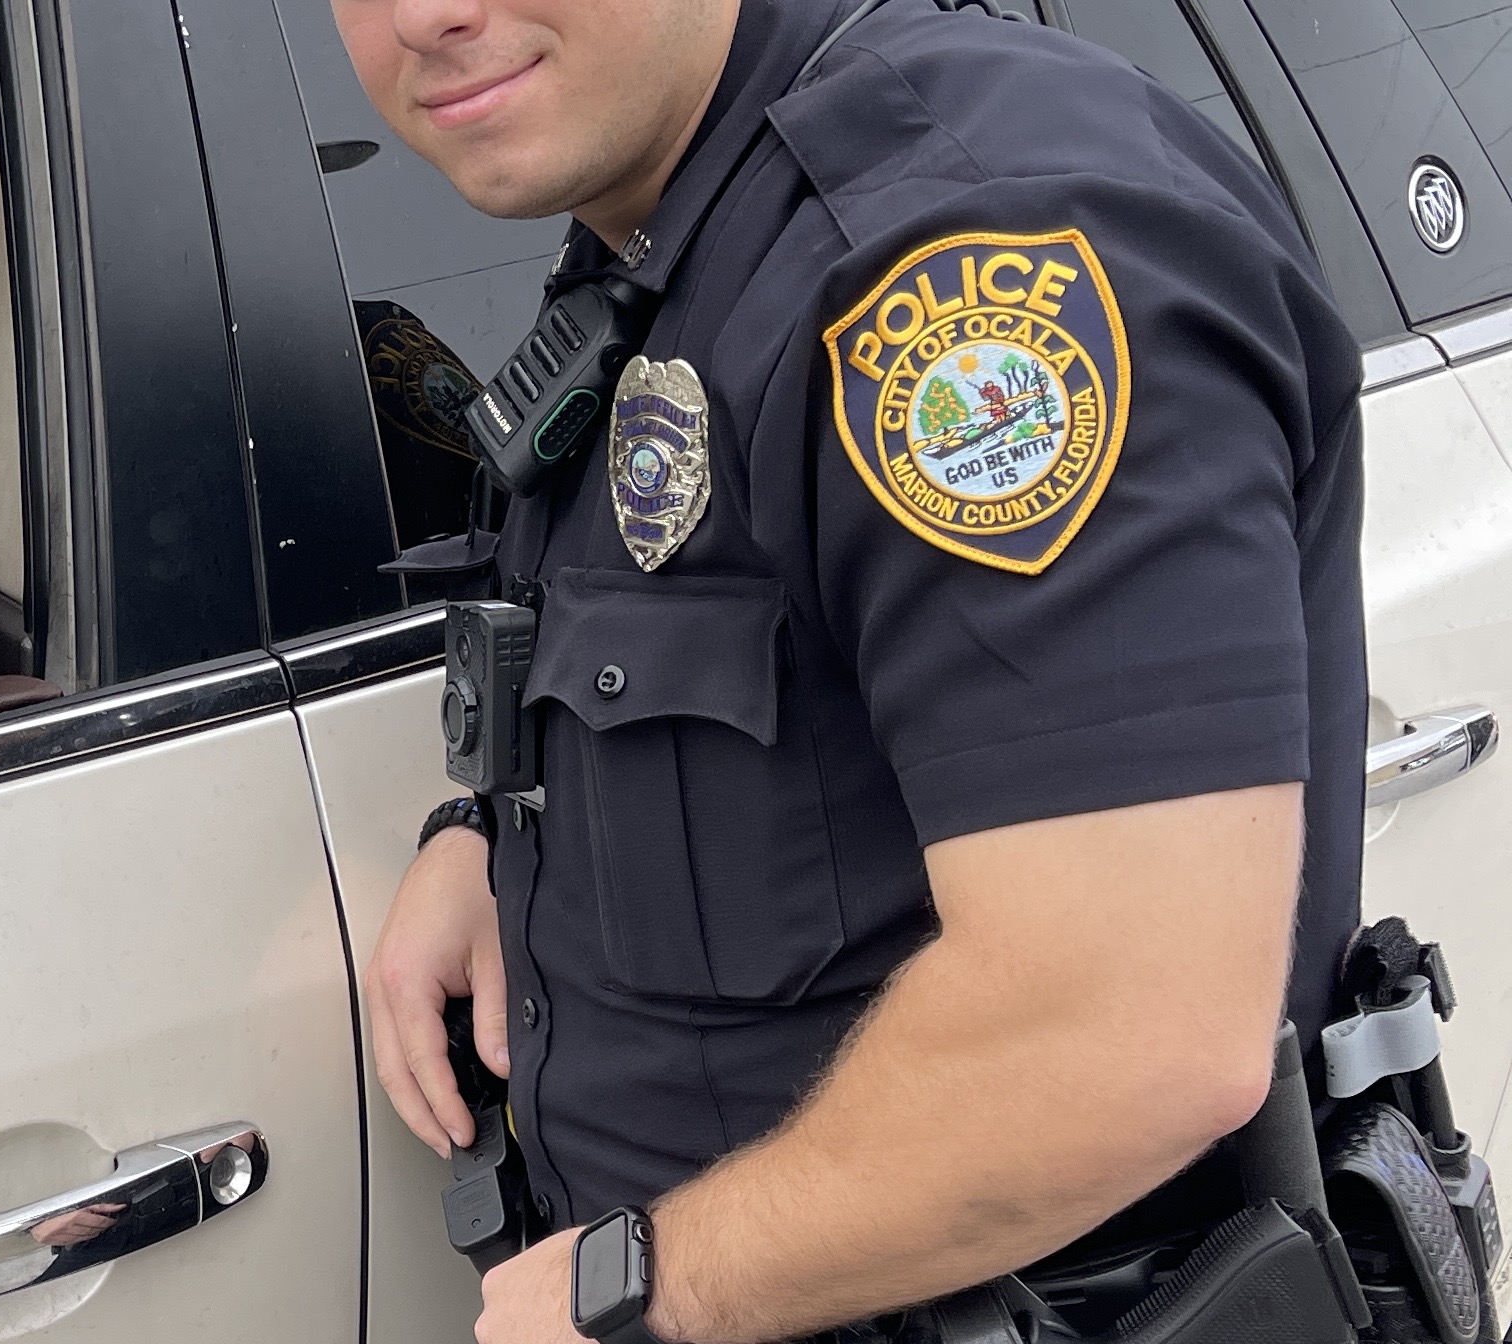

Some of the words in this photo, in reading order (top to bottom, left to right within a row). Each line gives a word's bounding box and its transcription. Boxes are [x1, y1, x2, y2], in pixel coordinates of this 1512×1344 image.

[849, 253, 1079, 382] POLICE
[882, 356, 923, 432] CITY
[917, 323, 958, 361] OF
[964, 314, 1077, 377] OCALA
[483, 392, 513, 434] MOTOROLA
[890, 452, 960, 523] MARION
[962, 475, 1067, 525] COUNTY,
[1056, 386, 1098, 486] FLORIDA
[945, 459, 983, 485] GOD
[986, 451, 1009, 471] BE
[1010, 438, 1057, 465] WITH
[991, 467, 1020, 489] US
[618, 482, 685, 514] POLICE
